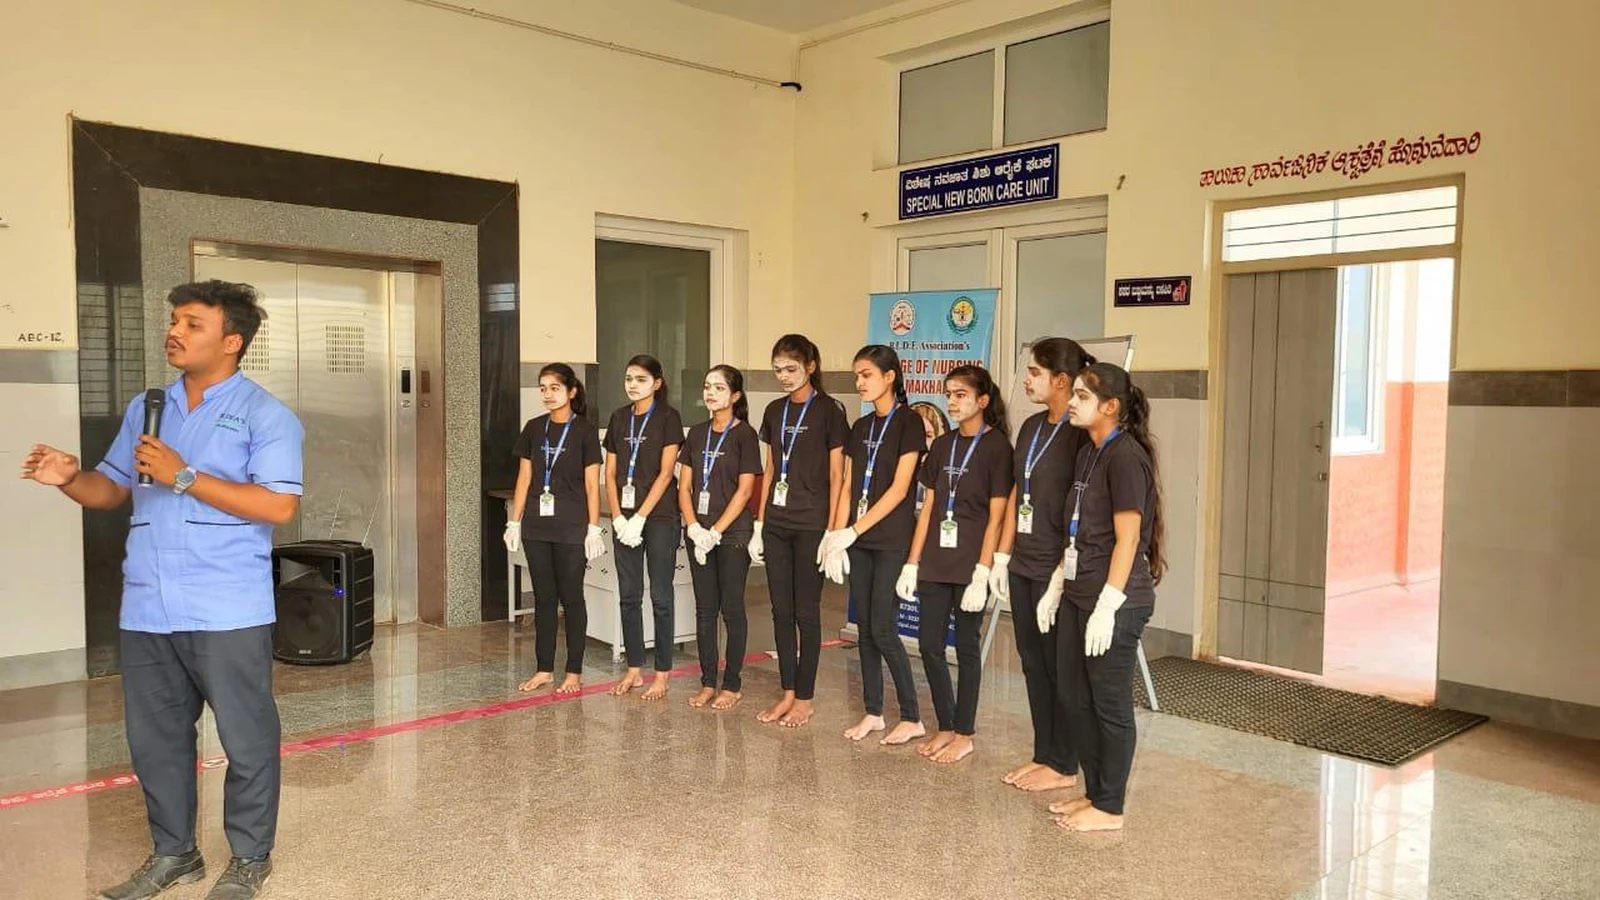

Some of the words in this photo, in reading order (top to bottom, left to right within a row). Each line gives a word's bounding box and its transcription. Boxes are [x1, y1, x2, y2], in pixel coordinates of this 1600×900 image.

[934, 168, 969, 187] ನವಜಾತ
[906, 195, 943, 213] SPECIAL
[944, 191, 966, 207] NEW
[967, 185, 994, 204] BORN
[996, 180, 1023, 201] CARE
[1025, 177, 1050, 196] UNIT
[920, 341, 970, 351] Association's
[915, 360, 929, 375] OF
